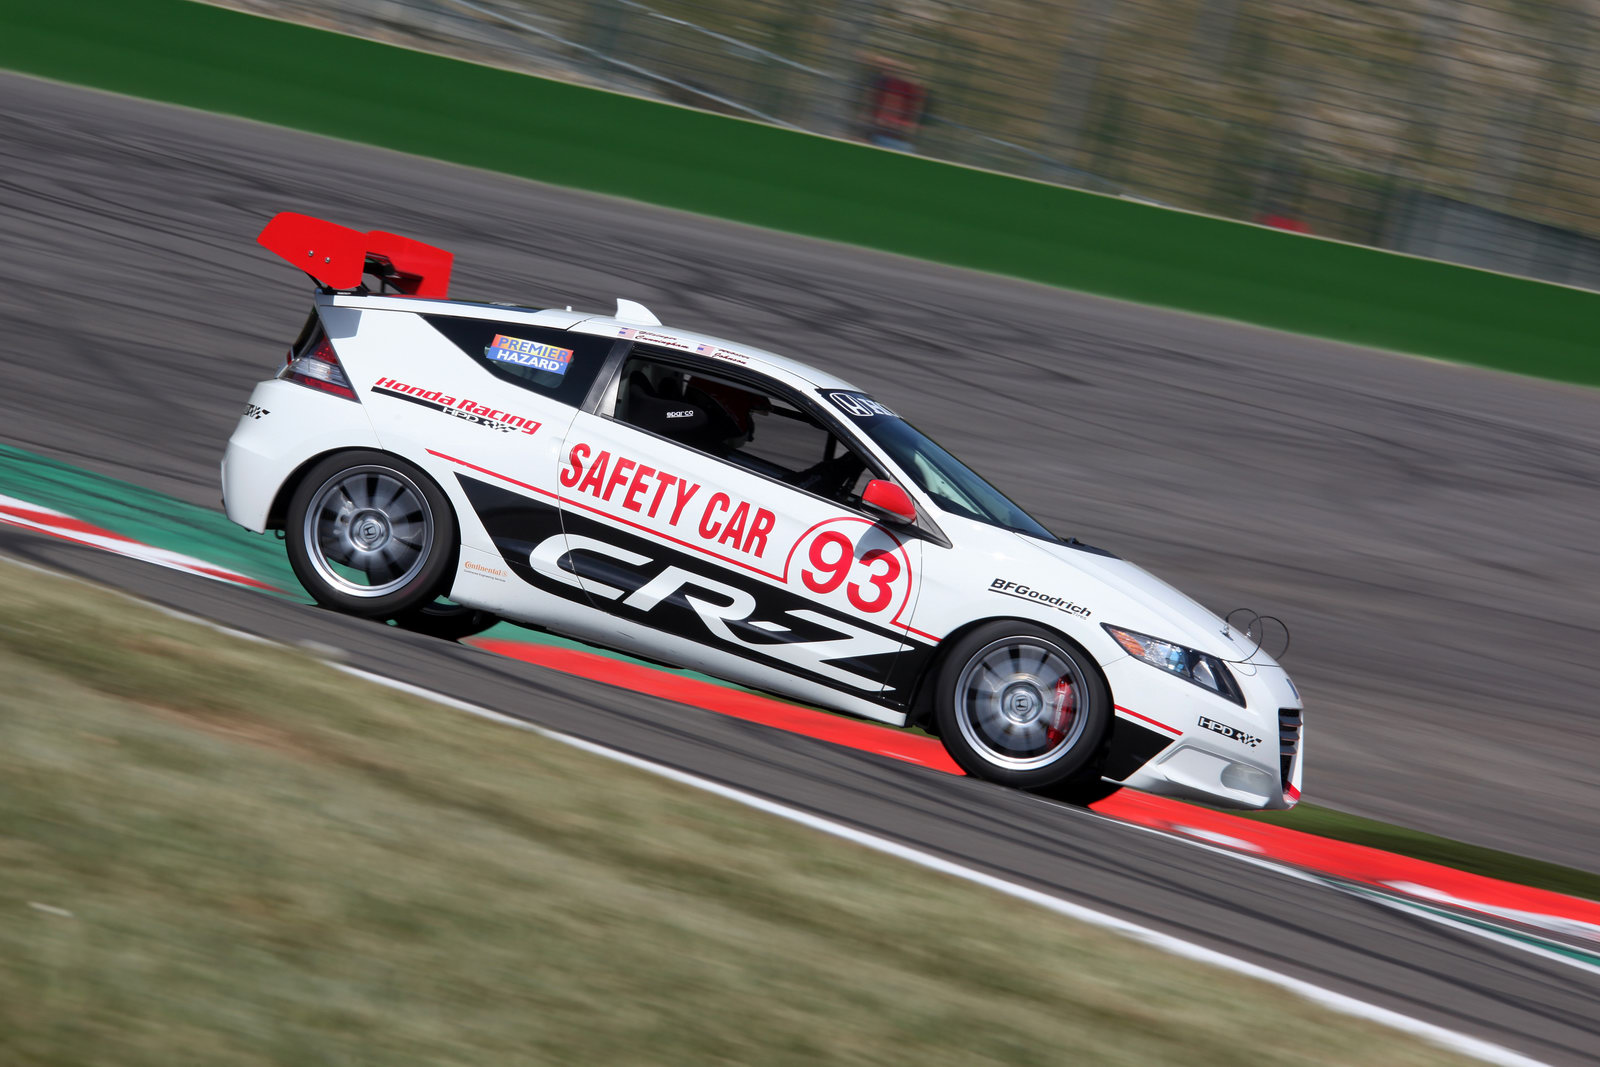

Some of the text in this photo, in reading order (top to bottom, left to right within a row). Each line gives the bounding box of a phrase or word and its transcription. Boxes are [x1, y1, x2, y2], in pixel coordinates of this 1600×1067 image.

[496, 349, 560, 371] HAZARD
[498, 336, 569, 362] PREMIER
[375, 376, 542, 435] Honda Racing
[560, 442, 776, 559] SAFETY CAR
[801, 530, 901, 614] 93
[529, 533, 915, 692] CR-Z
[990, 578, 1092, 617] BFGoodrich
[1199, 716, 1234, 737] HPD
